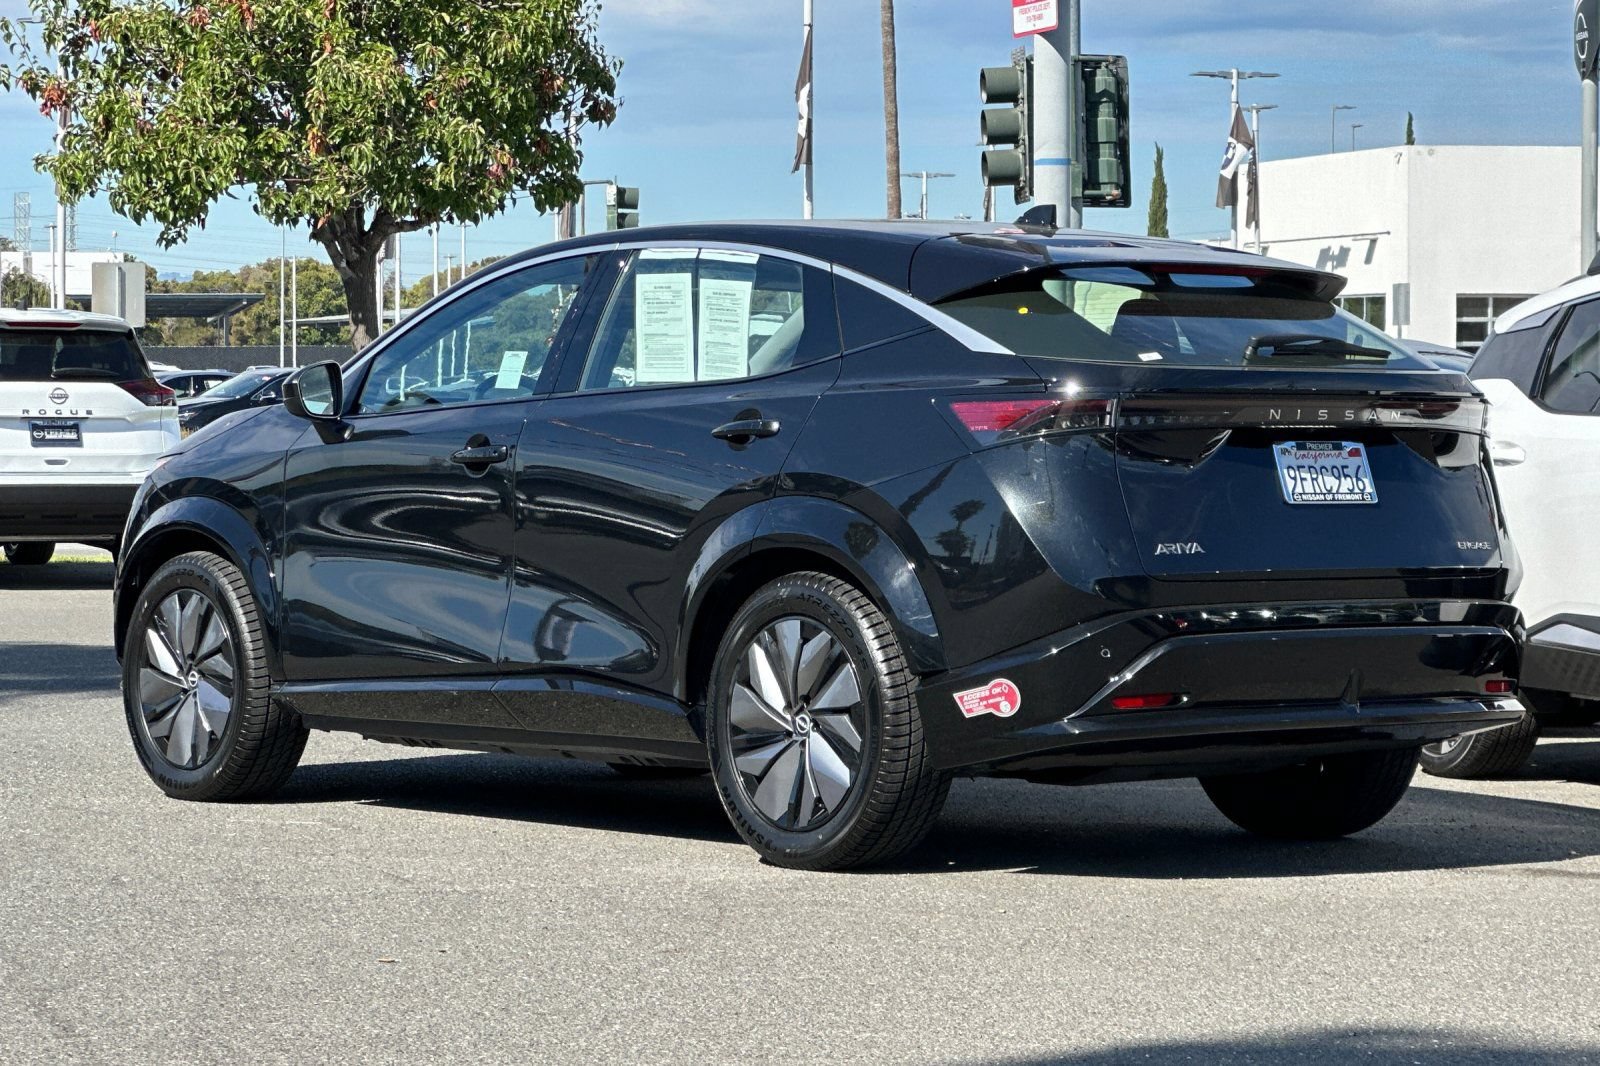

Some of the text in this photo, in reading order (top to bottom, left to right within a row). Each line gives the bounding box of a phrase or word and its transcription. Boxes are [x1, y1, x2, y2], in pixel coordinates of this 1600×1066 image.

[1269, 409, 1400, 420] NISSAN
[1306, 442, 1333, 450] PREMIER
[1294, 450, 1346, 464] California
[1286, 465, 1366, 493] 9FRC956
[1302, 493, 1363, 501] NISSAN OF FREMONT
[1154, 542, 1206, 556] ARIYA
[796, 592, 854, 639] ATREZZO
[963, 687, 1002, 701] ACCESS OK
